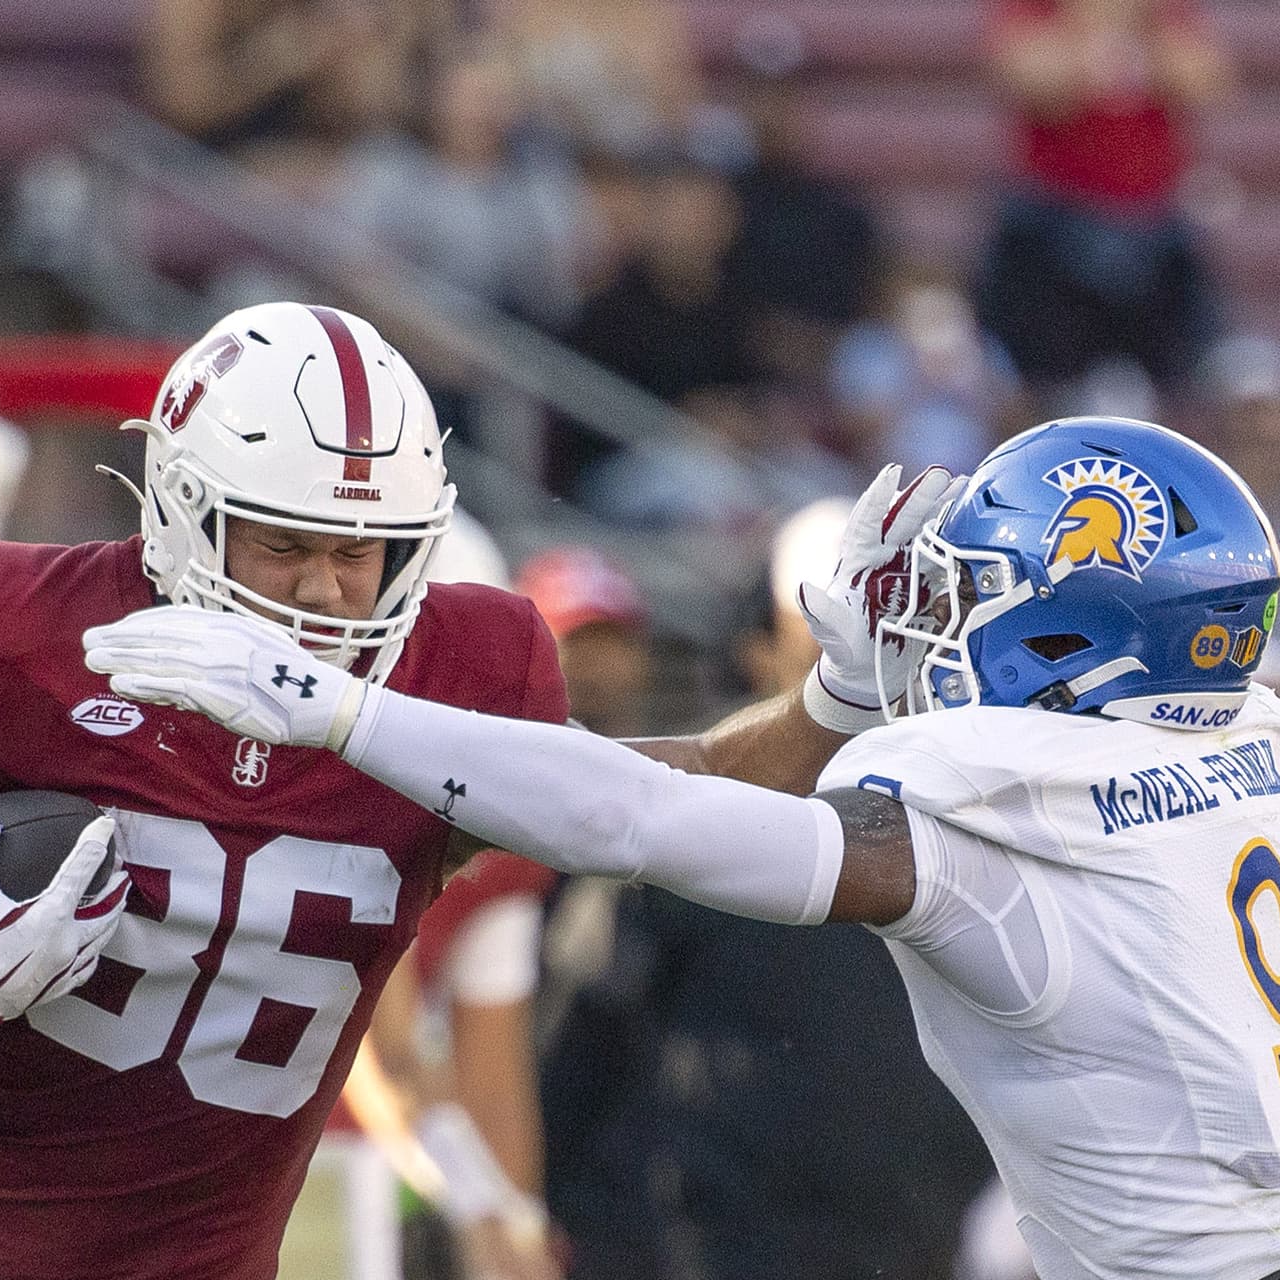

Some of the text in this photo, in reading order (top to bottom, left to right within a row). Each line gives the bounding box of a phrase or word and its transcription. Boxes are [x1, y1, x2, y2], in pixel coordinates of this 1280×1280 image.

[333, 486, 382, 501] CARDINAL
[1195, 636, 1225, 658] 89
[79, 704, 137, 723] ACC
[1150, 702, 1204, 726] SAN
[26, 806, 403, 1120] 86
